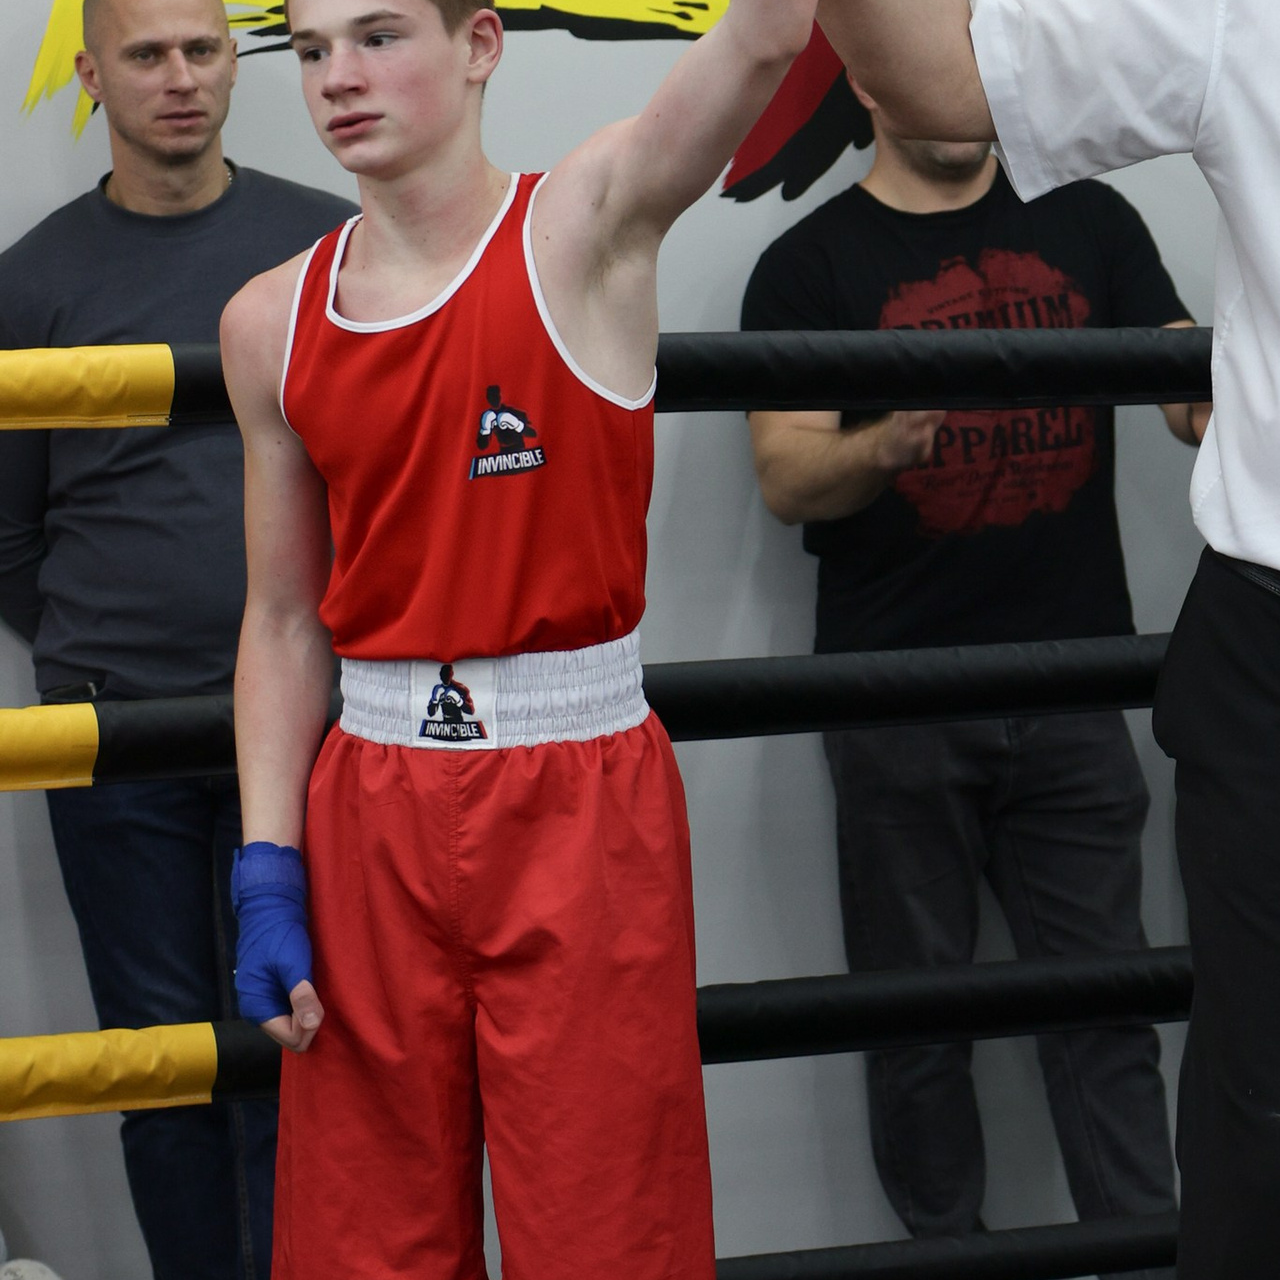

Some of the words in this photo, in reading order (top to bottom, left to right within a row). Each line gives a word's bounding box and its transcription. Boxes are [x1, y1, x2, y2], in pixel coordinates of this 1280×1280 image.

[912, 407, 1083, 470] PPAREL
[477, 449, 545, 475] INVINCIBLE
[425, 722, 480, 737] INVINCIBLE
